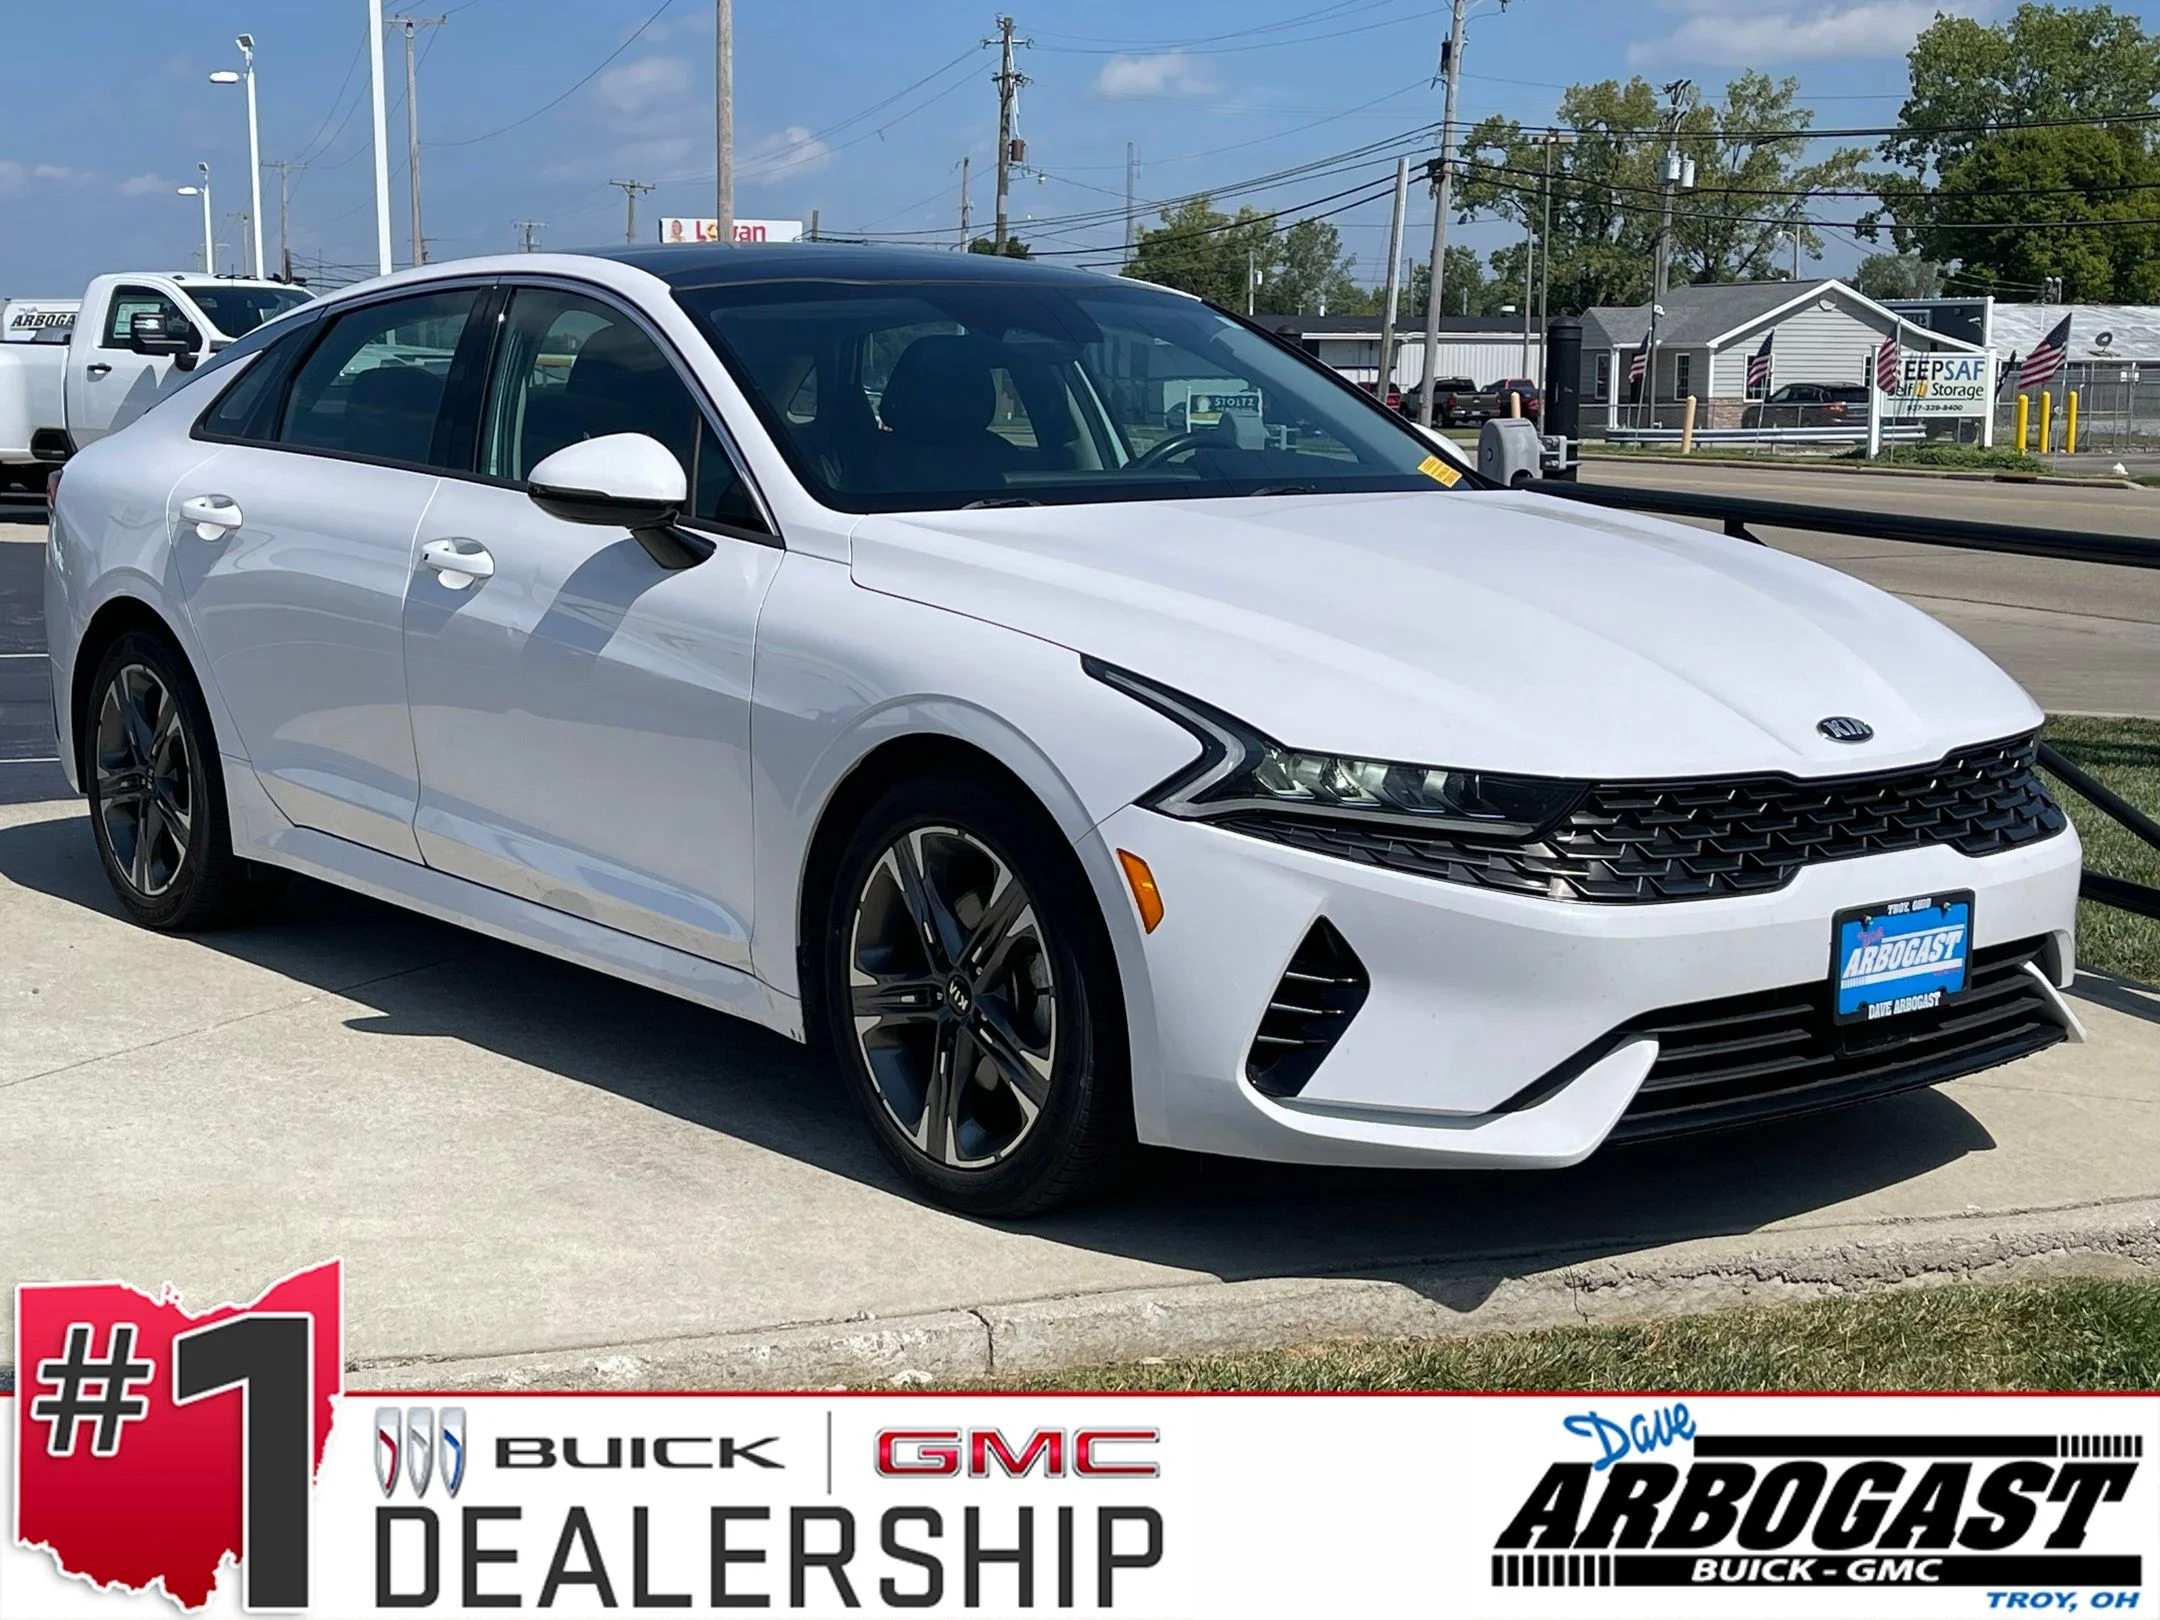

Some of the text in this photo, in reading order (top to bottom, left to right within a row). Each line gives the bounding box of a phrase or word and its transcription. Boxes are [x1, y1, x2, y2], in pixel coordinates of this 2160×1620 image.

[1898, 359, 1985, 381] EEPSAF
[1931, 382, 1984, 400] Storage
[1214, 397, 1254, 407] STOLTZ
[1823, 719, 1870, 738] KIA
[1842, 930, 1963, 978] ARBOGAST
[1868, 991, 1941, 1020] DAVE ARBOGAST
